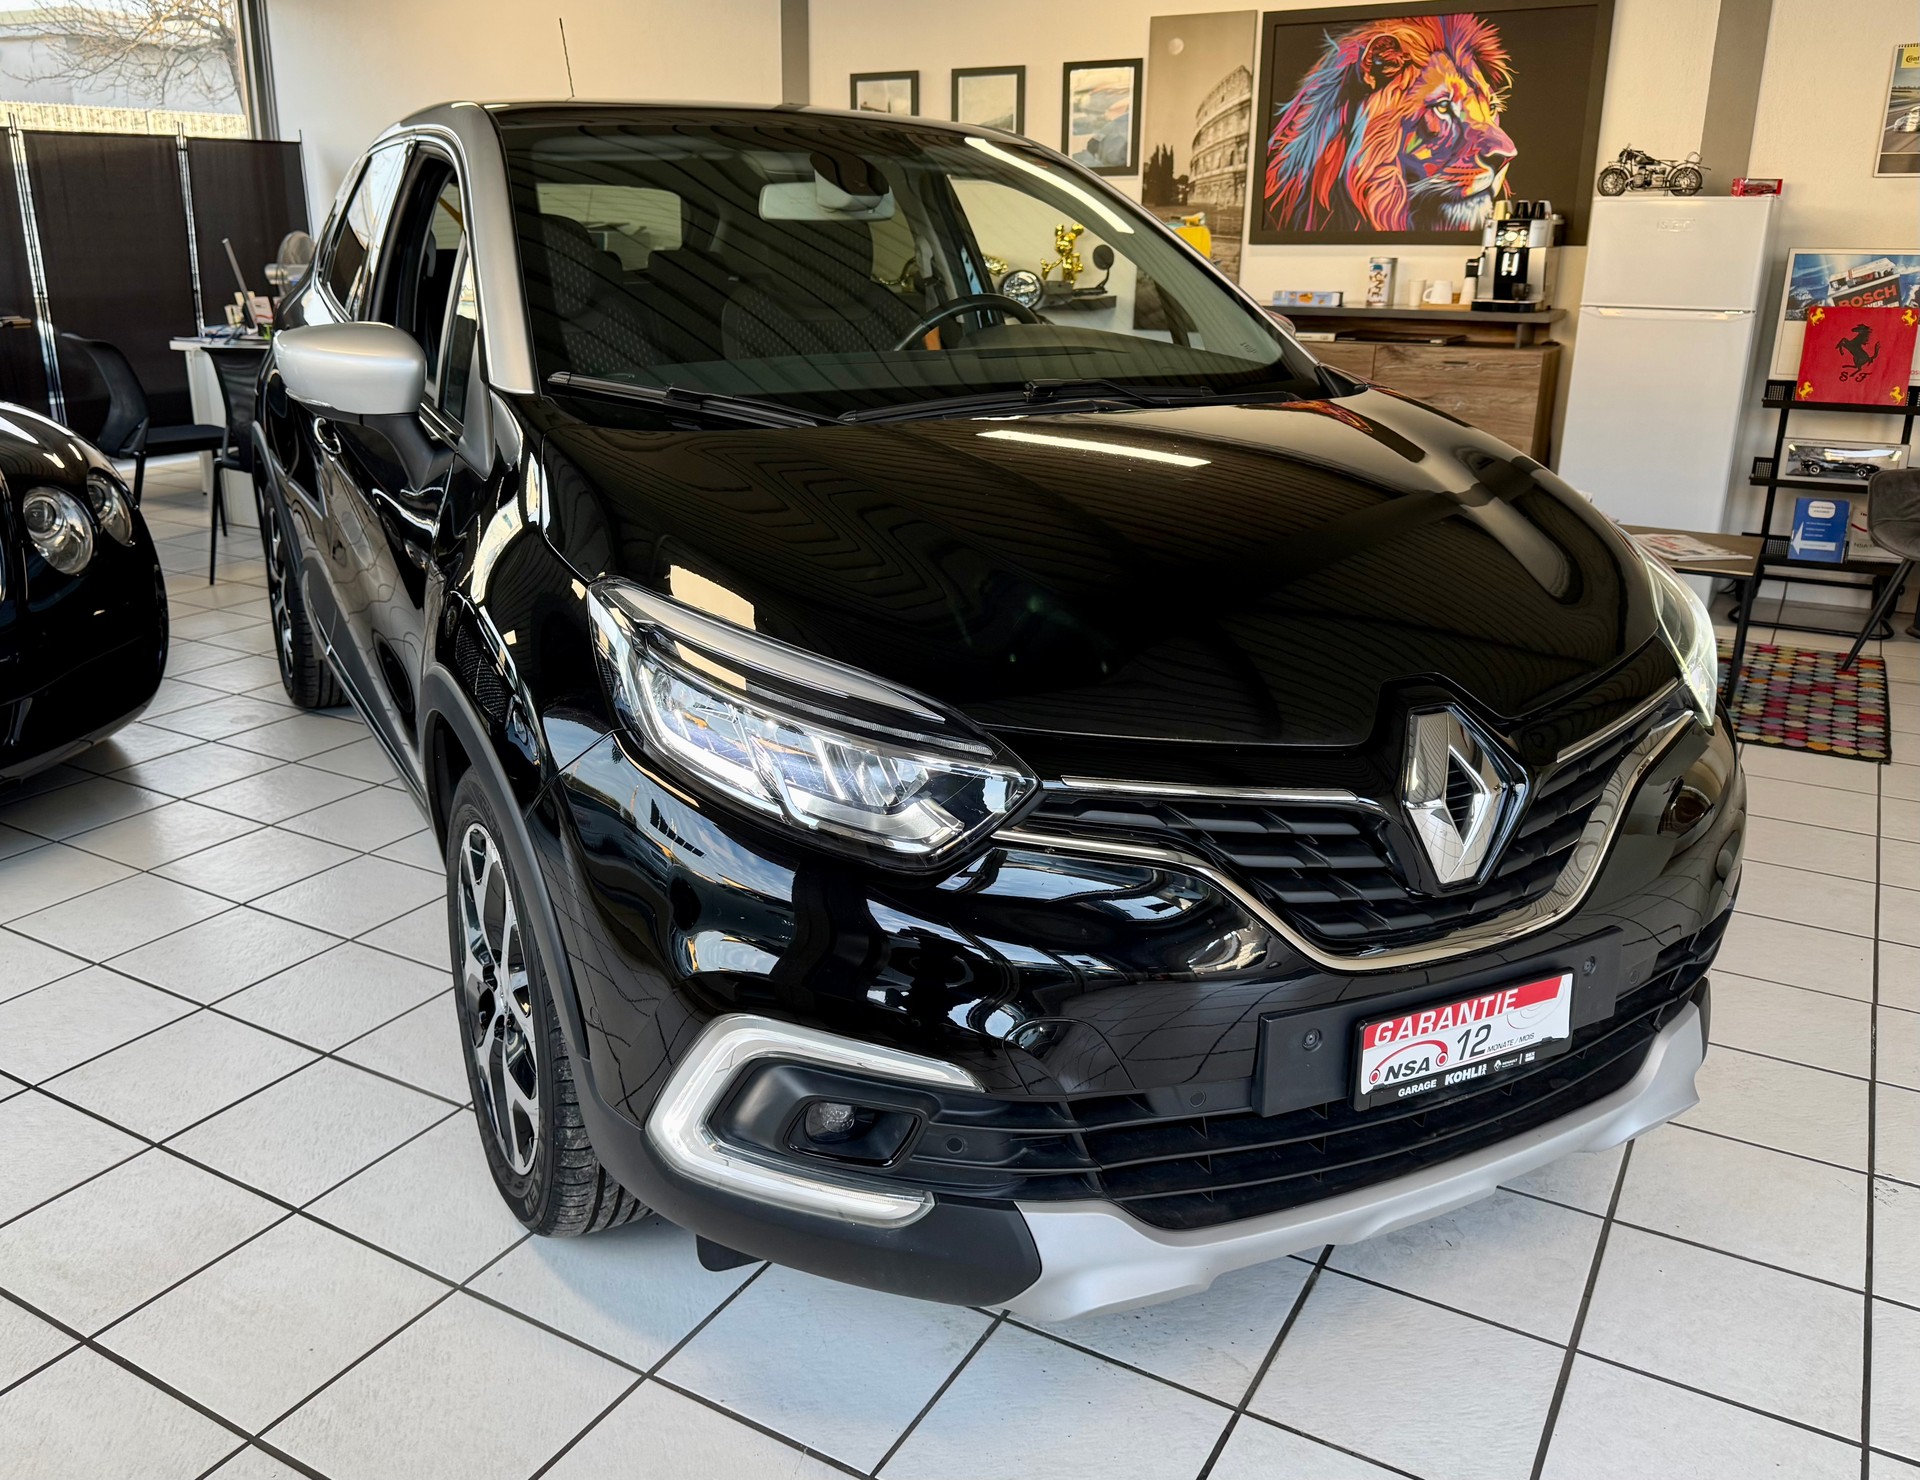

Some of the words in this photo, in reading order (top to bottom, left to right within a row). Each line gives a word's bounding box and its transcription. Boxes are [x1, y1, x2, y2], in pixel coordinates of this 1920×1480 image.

[1839, 284, 1897, 307] BOSCH
[1374, 988, 1518, 1047] GARANTIE
[1457, 1023, 1492, 1061] 12
[1487, 1038, 1514, 1053] MONATE
[1519, 1032, 1535, 1043] MOIS
[1384, 1056, 1430, 1083] NSA
[1398, 1078, 1437, 1097] GARAGE
